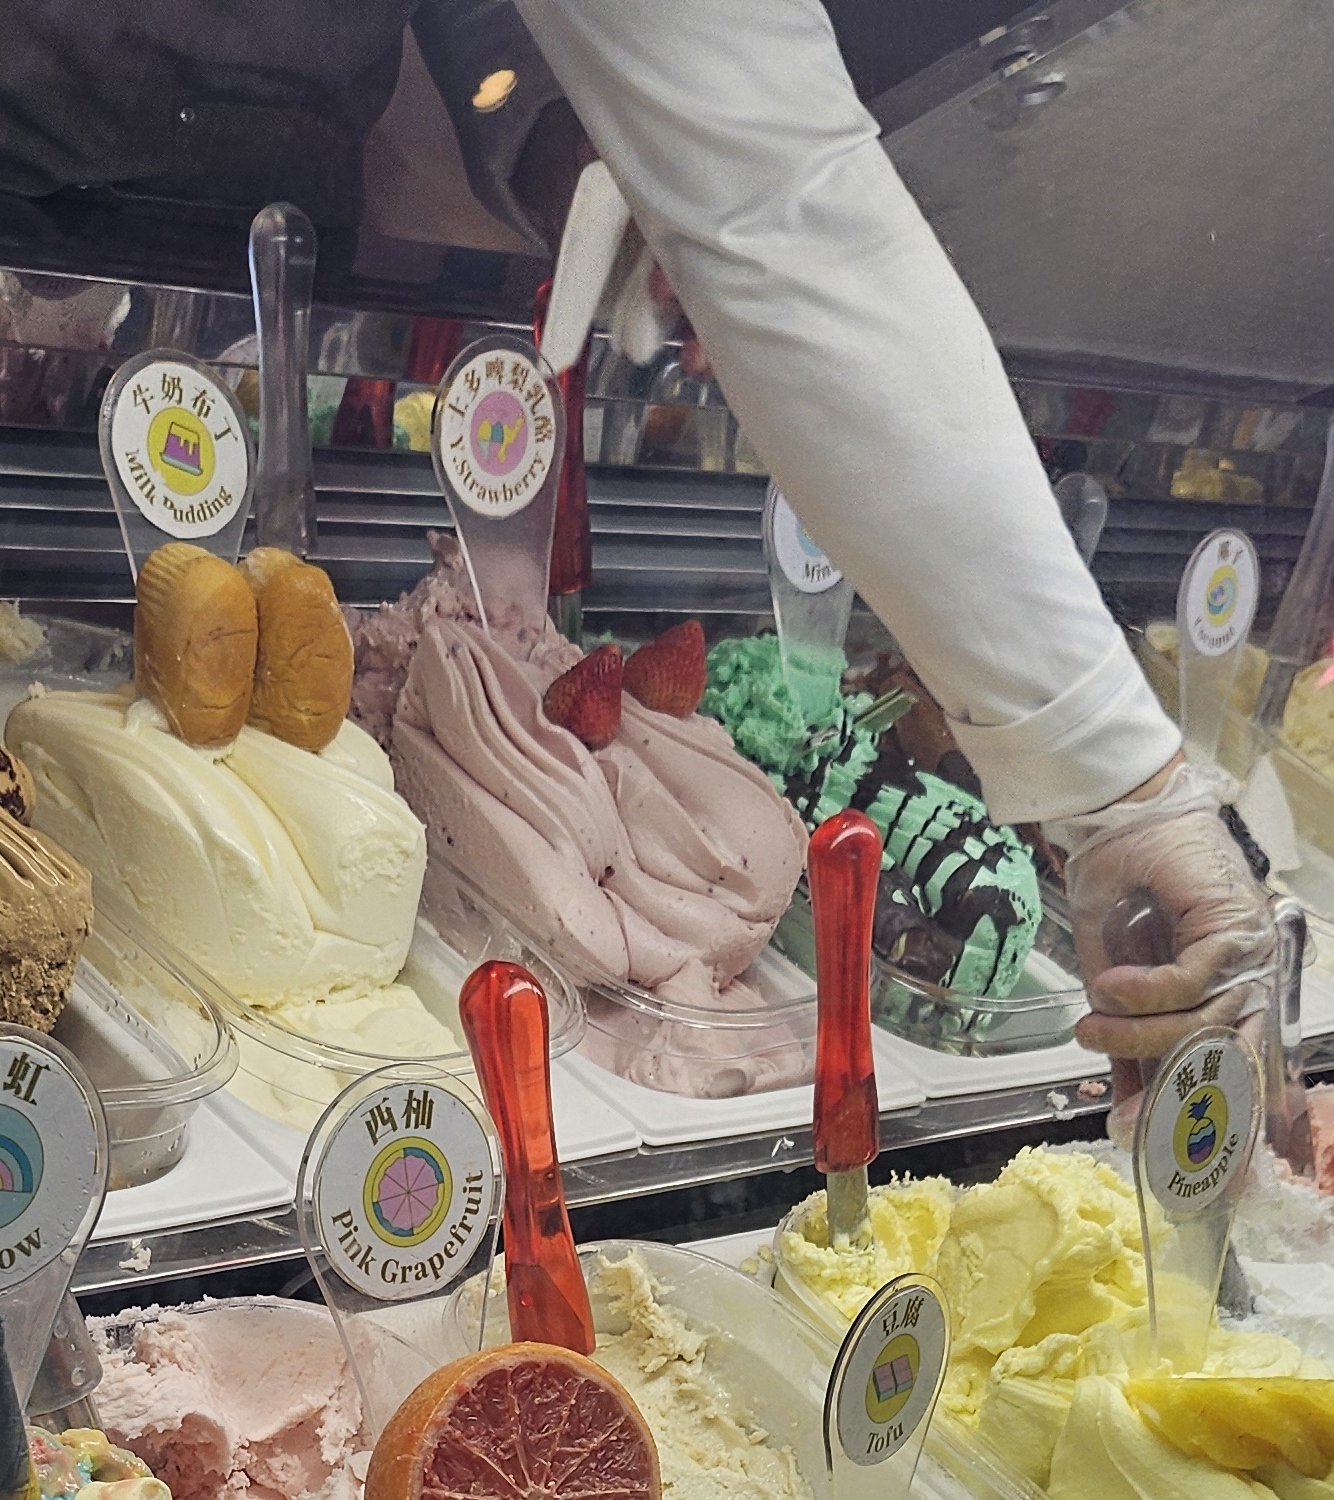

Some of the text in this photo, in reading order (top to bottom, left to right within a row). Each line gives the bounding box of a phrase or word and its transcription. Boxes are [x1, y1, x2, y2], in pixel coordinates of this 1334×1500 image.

[132, 373, 239, 443] 牛奶布丁
[360, 1089, 435, 1146] 西柚
[1167, 1132, 1240, 1199] Pineapple
[331, 1169, 484, 1285] Pink Grapefruit
[879, 1295, 925, 1343] 豆腐
[866, 1421, 905, 1455] Tofu
